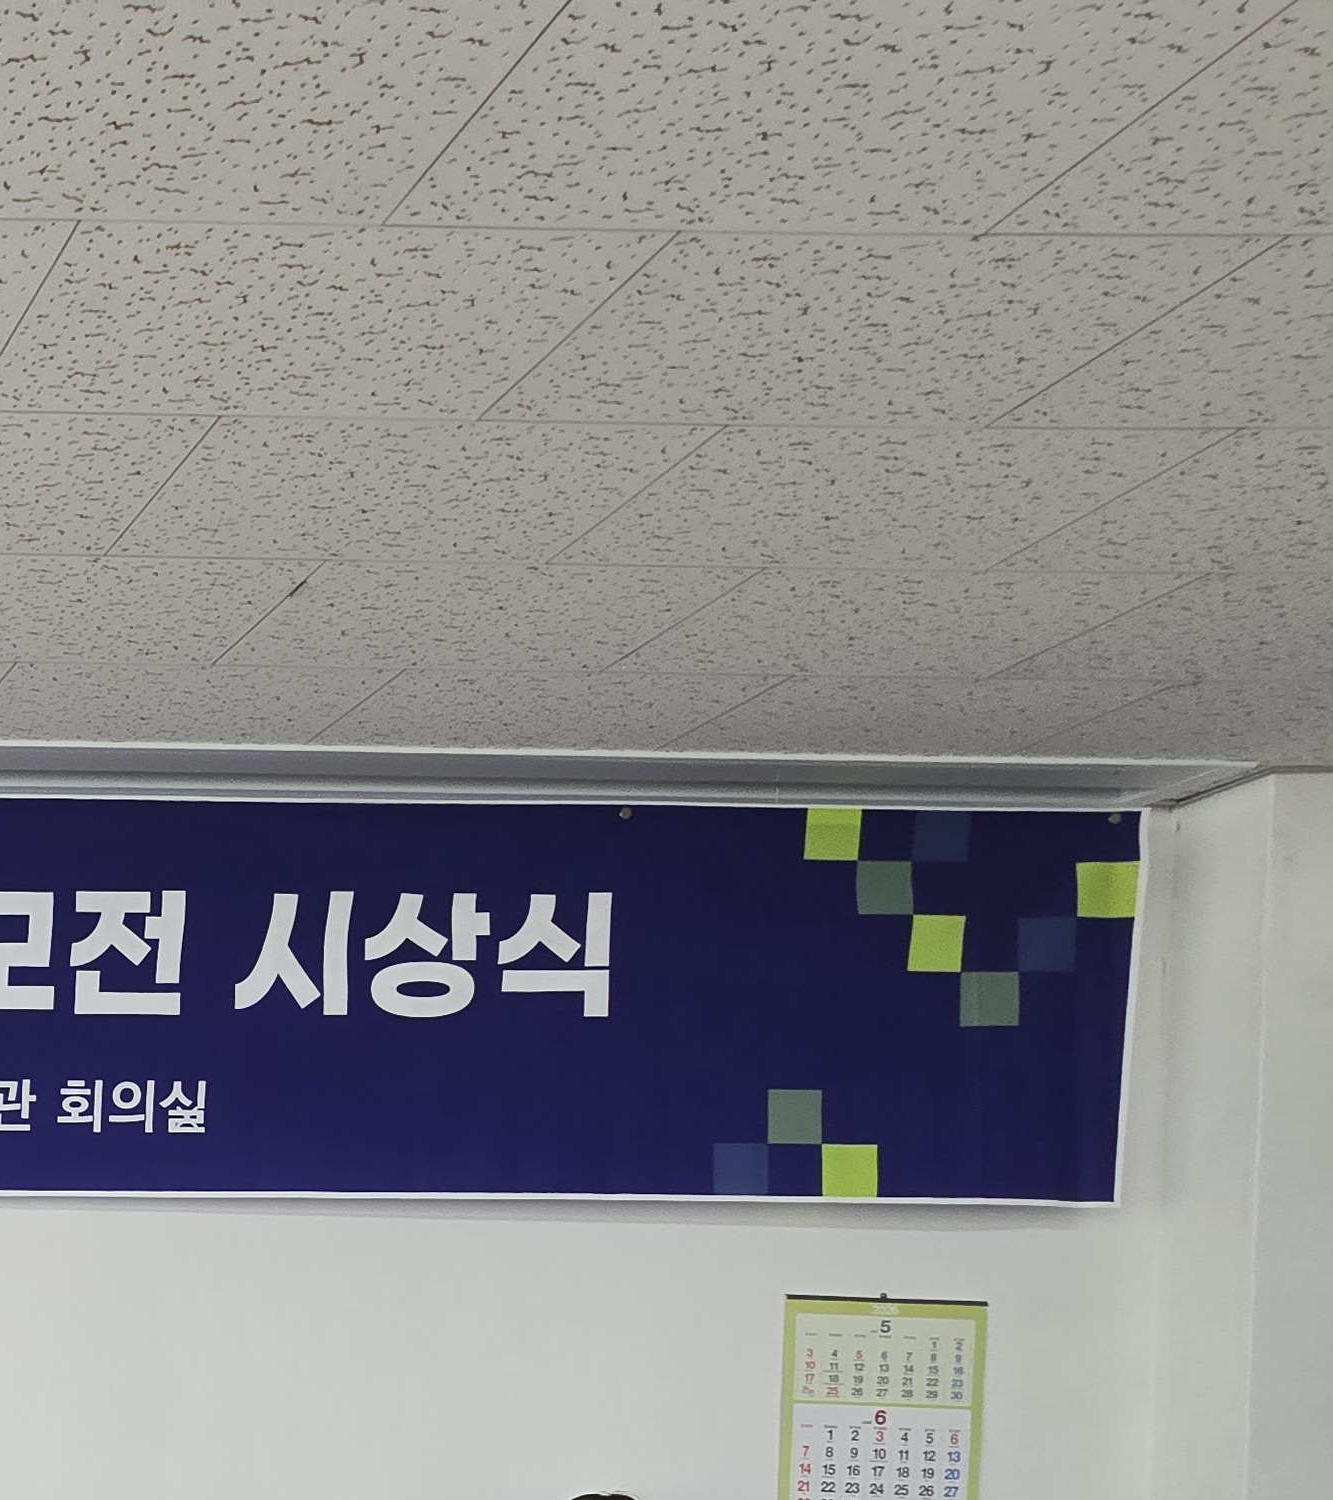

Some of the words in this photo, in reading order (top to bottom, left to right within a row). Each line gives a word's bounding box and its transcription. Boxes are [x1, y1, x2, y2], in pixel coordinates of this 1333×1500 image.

[235, 888, 614, 1018] 시상식
[57, 1079, 207, 1133] 회의실
[880, 1320, 891, 1333] 5
[875, 1410, 887, 1425] 6
[827, 1430, 833, 1440] 1
[851, 1430, 859, 1441] 2
[875, 1431, 884, 1442] 3
[900, 1432, 908, 1442] 4
[926, 1433, 933, 1444] 5
[950, 1434, 958, 1445] 6
[802, 1445, 809, 1457] 7
[825, 1446, 833, 1458] 8
[850, 1447, 858, 1458] 9
[873, 1448, 886, 1460] 10
[898, 1450, 909, 1460] 11
[923, 1451, 936, 1462] 12
[947, 1451, 960, 1463] 13
[799, 1463, 811, 1474] 14
[822, 1464, 835, 1475] 15
[847, 1465, 860, 1476] 16
[872, 1466, 885, 1477] 17
[896, 1466, 910, 1478] 18
[921, 1467, 934, 1479] 19
[944, 1468, 960, 1480] 20
[798, 1480, 810, 1491] 21
[821, 1481, 835, 1493] 22
[845, 1482, 860, 1494] 23
[869, 1483, 884, 1494] 24
[894, 1484, 909, 1496] 25
[919, 1485, 934, 1496] 26
[944, 1486, 959, 1497] 27
